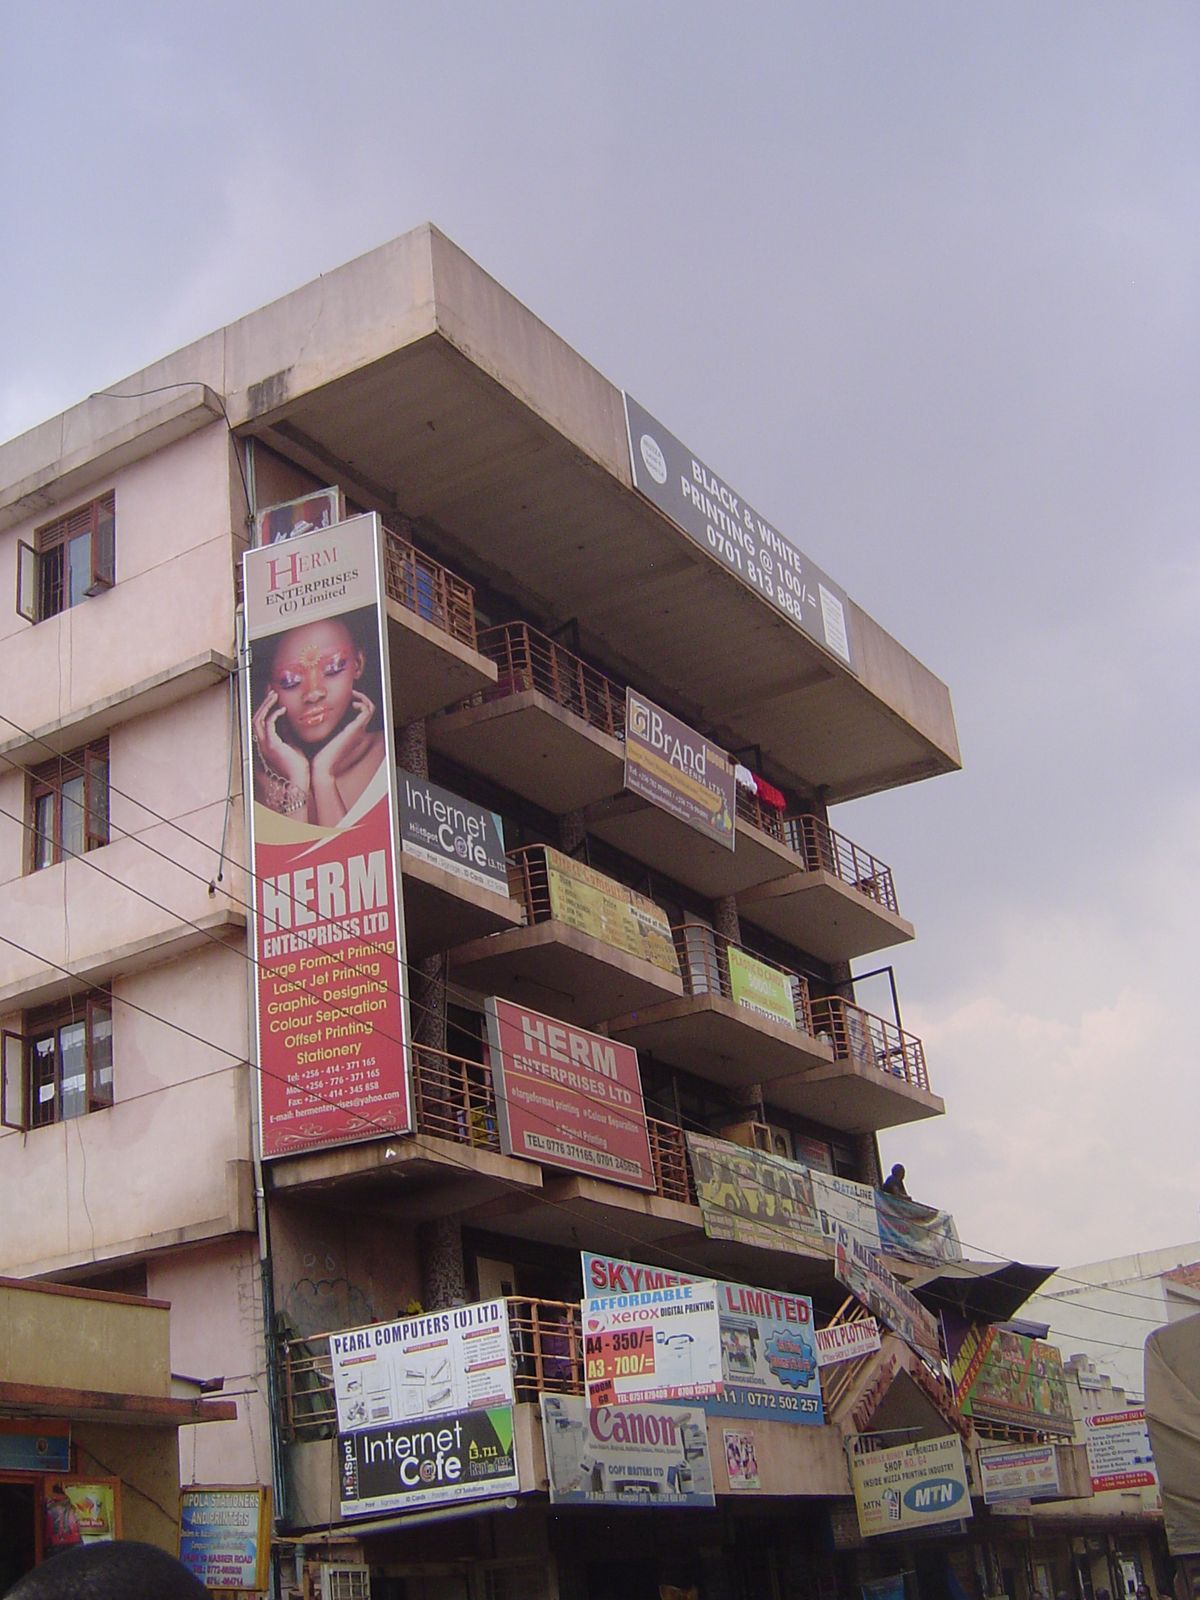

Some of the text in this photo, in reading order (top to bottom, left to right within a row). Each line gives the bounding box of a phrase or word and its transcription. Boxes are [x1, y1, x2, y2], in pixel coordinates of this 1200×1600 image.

[691, 460, 739, 519] BLACK
[744, 510, 755, 533] &
[757, 520, 801, 574] WHITE
[681, 476, 816, 608] PRINTING @ 100/=
[266, 547, 338, 592] HERM
[707, 525, 802, 620] 0701 813 888
[266, 569, 359, 605] ENTERPRISES
[279, 586, 346, 616] (U) Limited
[406, 780, 486, 841] Internet
[262, 849, 389, 934] HERM
[263, 911, 389, 959] ENTERPRISES LTD
[261, 940, 396, 980] Large Format Printing
[273, 962, 380, 995] Laser Jet Printing
[267, 979, 388, 1014] Graphic Designing
[270, 999, 387, 1033] Colour Separation
[284, 1020, 374, 1049] Offset Printing
[522, 1015, 618, 1080] HERM
[296, 1042, 362, 1065] Stationery
[326, 1064, 340, 1074] 414
[346, 1060, 360, 1071] 371
[362, 1056, 376, 1067] 165
[306, 1080, 324, 1090] +256
[330, 1076, 345, 1086] 776
[351, 1072, 364, 1082] 371
[367, 1068, 380, 1079] 165
[328, 1088, 343, 1098] 414
[513, 1054, 632, 1105] ENTERPRISES LTD
[527, 1134, 545, 1149] TEL:
[546, 1139, 565, 1154] 0776
[589, 1286, 692, 1312] AFFORDABLE
[611, 1300, 715, 1325] xerox DIGITAL PRINTING
[725, 1286, 810, 1325] LIMITED
[334, 1333, 372, 1354] PEARL
[375, 1315, 450, 1346] COMPUTERS
[454, 1310, 473, 1329] (U)
[477, 1303, 503, 1324] LTD.
[586, 1330, 653, 1354] A4 350/=
[815, 1329, 841, 1351] VINYL
[840, 1319, 877, 1345] PLOTTING
[588, 1353, 654, 1378] A3 700/=
[589, 1379, 612, 1394] ROOM
[747, 1391, 777, 1408] 0772
[779, 1396, 799, 1411] 502
[801, 1398, 819, 1412] 257
[364, 1420, 463, 1464] Internet
[589, 1407, 677, 1447] Canon
[884, 1460, 902, 1473] SHOP
[915, 1483, 953, 1508] MTN
